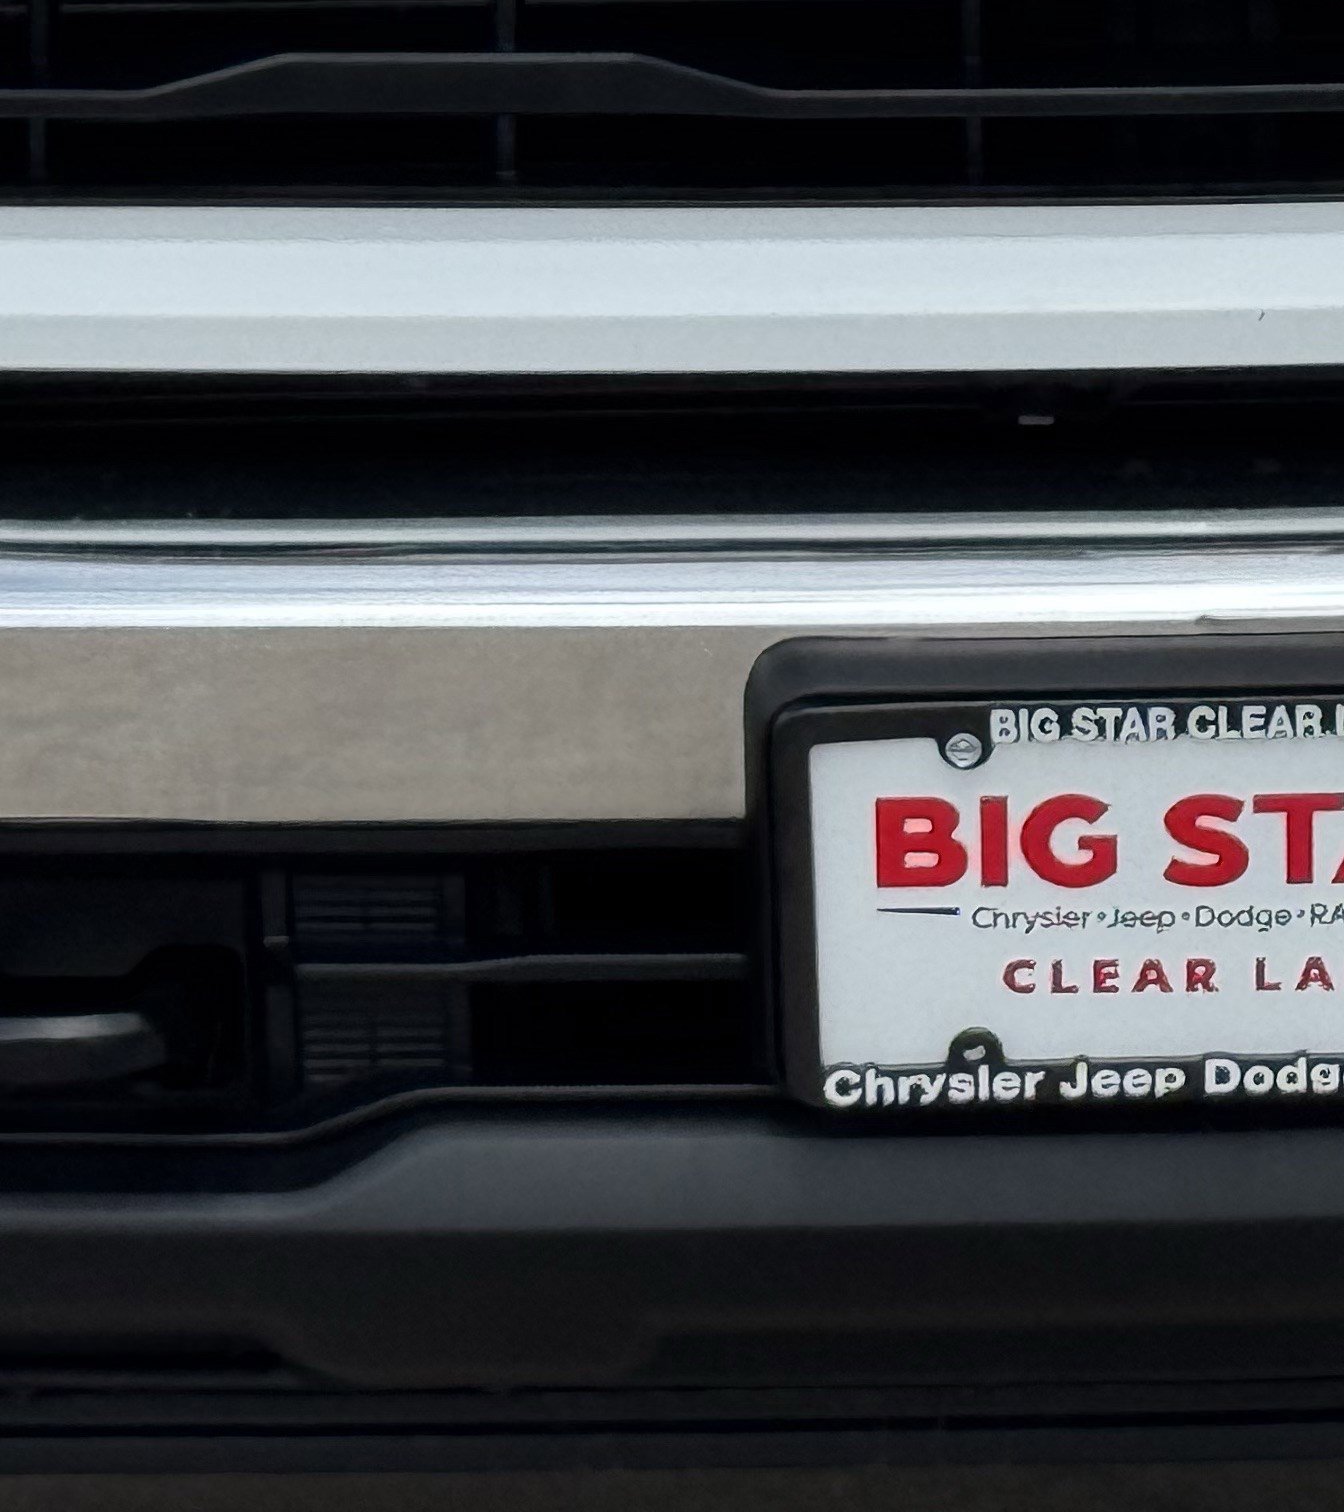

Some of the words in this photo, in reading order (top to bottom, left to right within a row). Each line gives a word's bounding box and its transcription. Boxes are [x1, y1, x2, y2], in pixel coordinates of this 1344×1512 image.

[988, 706, 1062, 744] BIG
[1071, 705, 1176, 743] STAR
[1186, 703, 1324, 741] CLEAR
[874, 792, 1118, 889] BIG
[1194, 903, 1292, 932] Dodge
[1002, 957, 1219, 995] CLEAR
[822, 1064, 1046, 1108] Chrysler
[1059, 1061, 1187, 1100] Jeep
